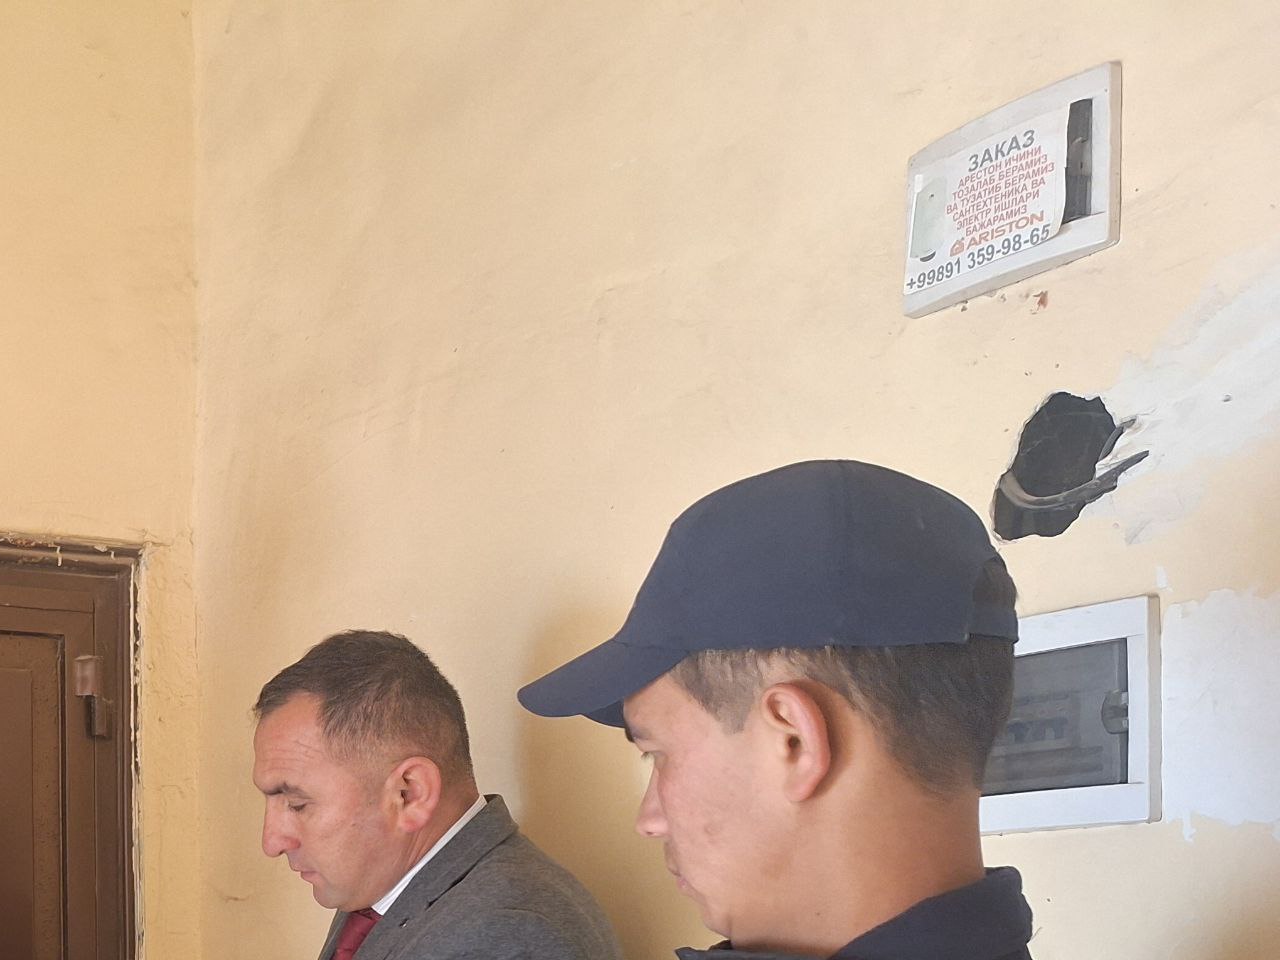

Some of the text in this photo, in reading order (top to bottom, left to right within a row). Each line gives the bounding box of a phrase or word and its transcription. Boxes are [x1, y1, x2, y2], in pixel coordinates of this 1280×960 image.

[958, 145, 1042, 188] АРЕСТОН ИЧИНИ
[968, 129, 1035, 172] ЗАКАЗ
[946, 203, 958, 215] ВА
[1004, 162, 1055, 189] БЕРАМИЗ
[952, 154, 1048, 201] ТОЗАЛАБ БЕРАМИЗ
[1031, 177, 1046, 190] ВА
[956, 189, 1040, 231] ЭЛЕКТР ИШЛАРИ
[965, 204, 1028, 236] БАЖАРАМИЗ
[966, 210, 1044, 250] ARISTON
[907, 223, 1051, 290] +99891 359-98-65
